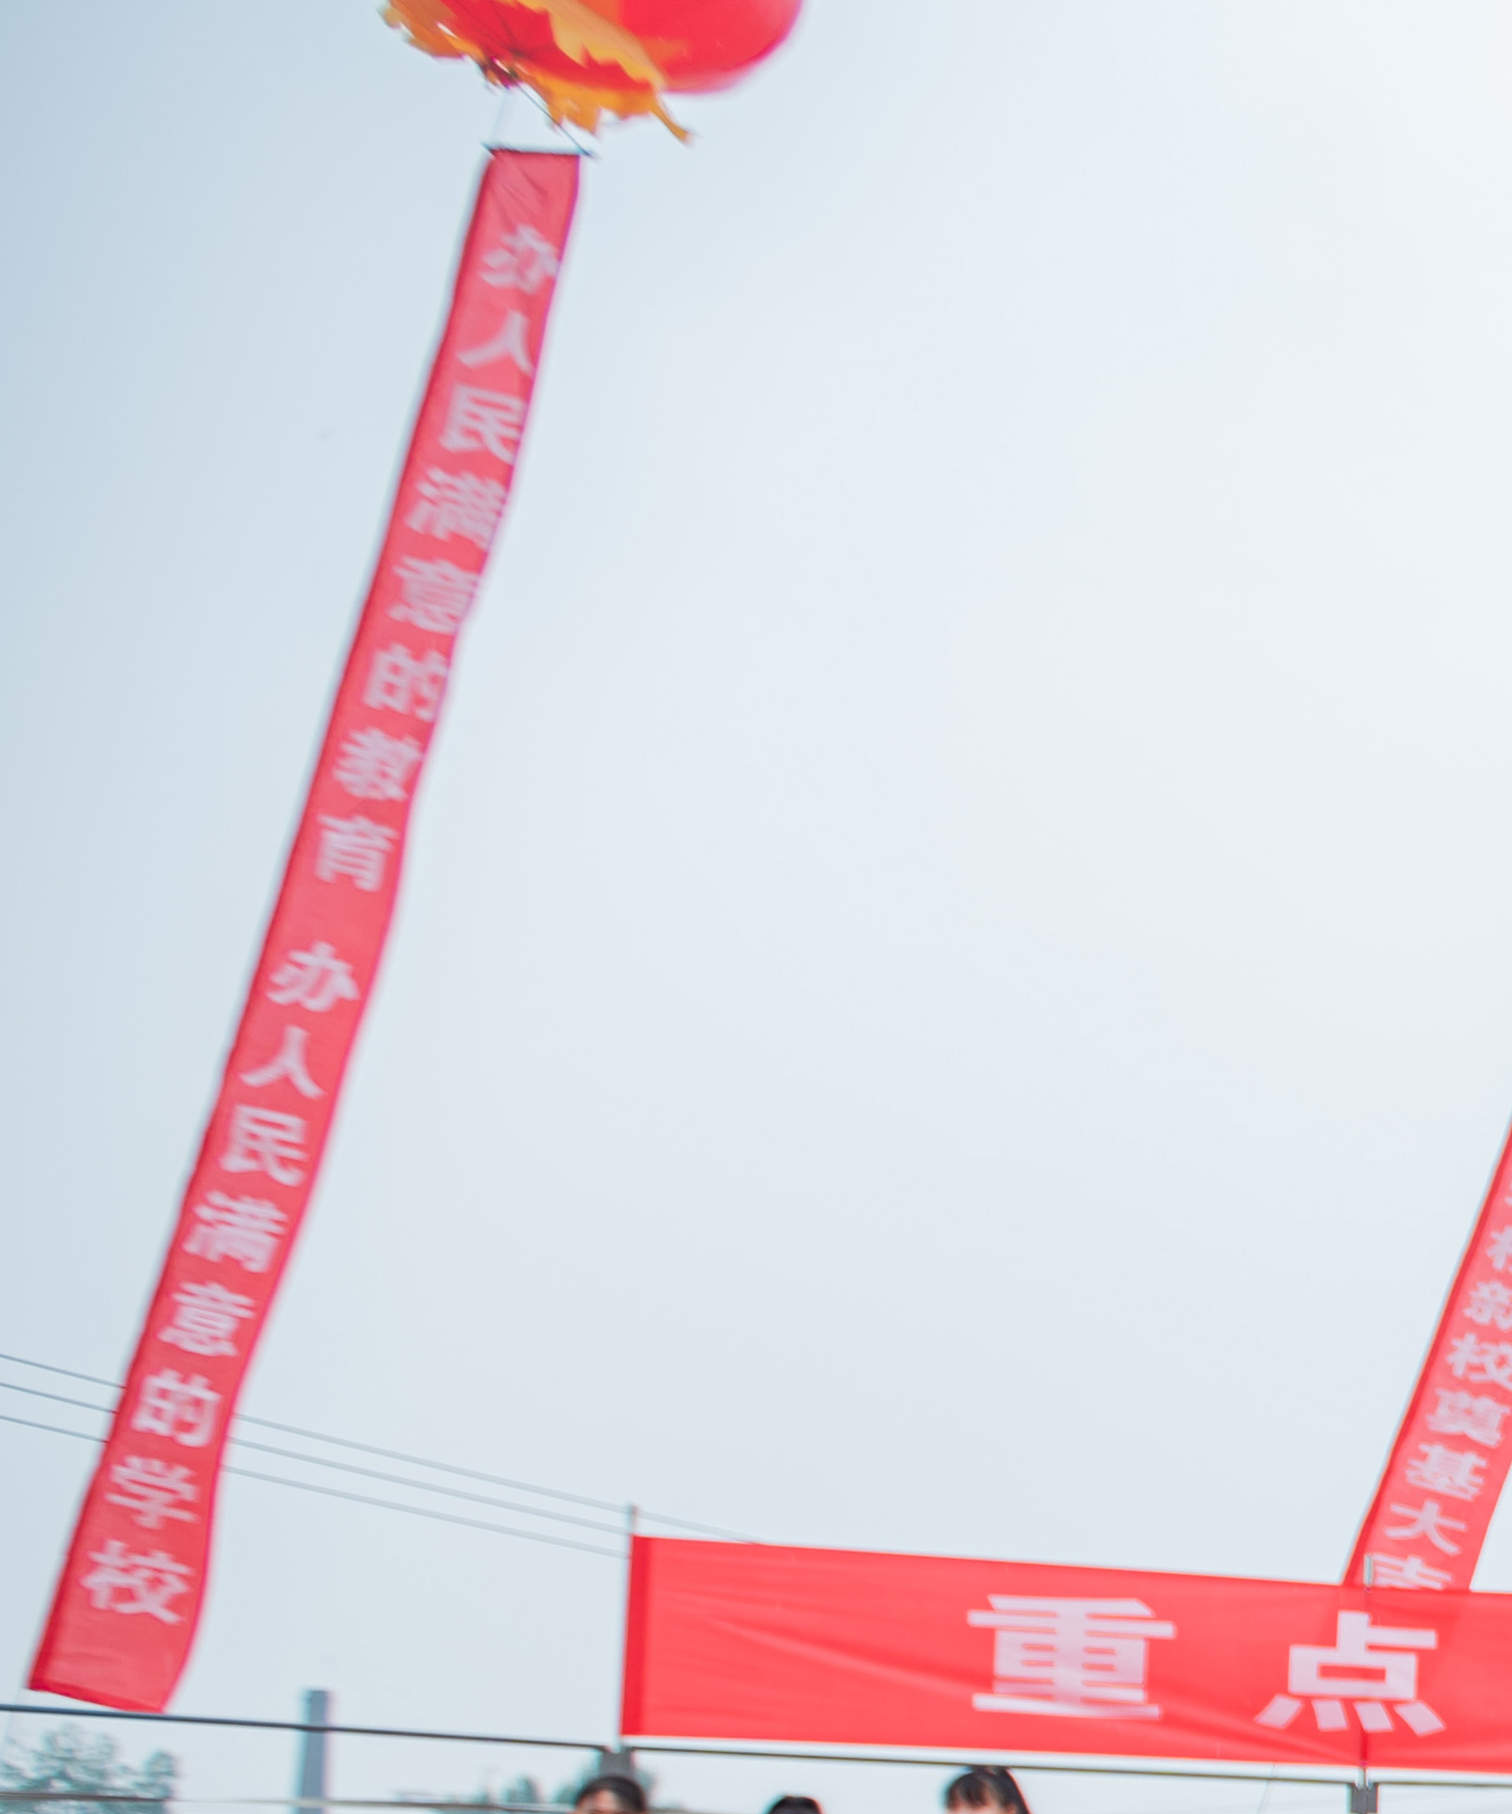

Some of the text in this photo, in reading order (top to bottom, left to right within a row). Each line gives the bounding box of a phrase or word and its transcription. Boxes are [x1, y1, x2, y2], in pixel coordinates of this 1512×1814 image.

[80, 941, 361, 1627] 办人民满意的学校
